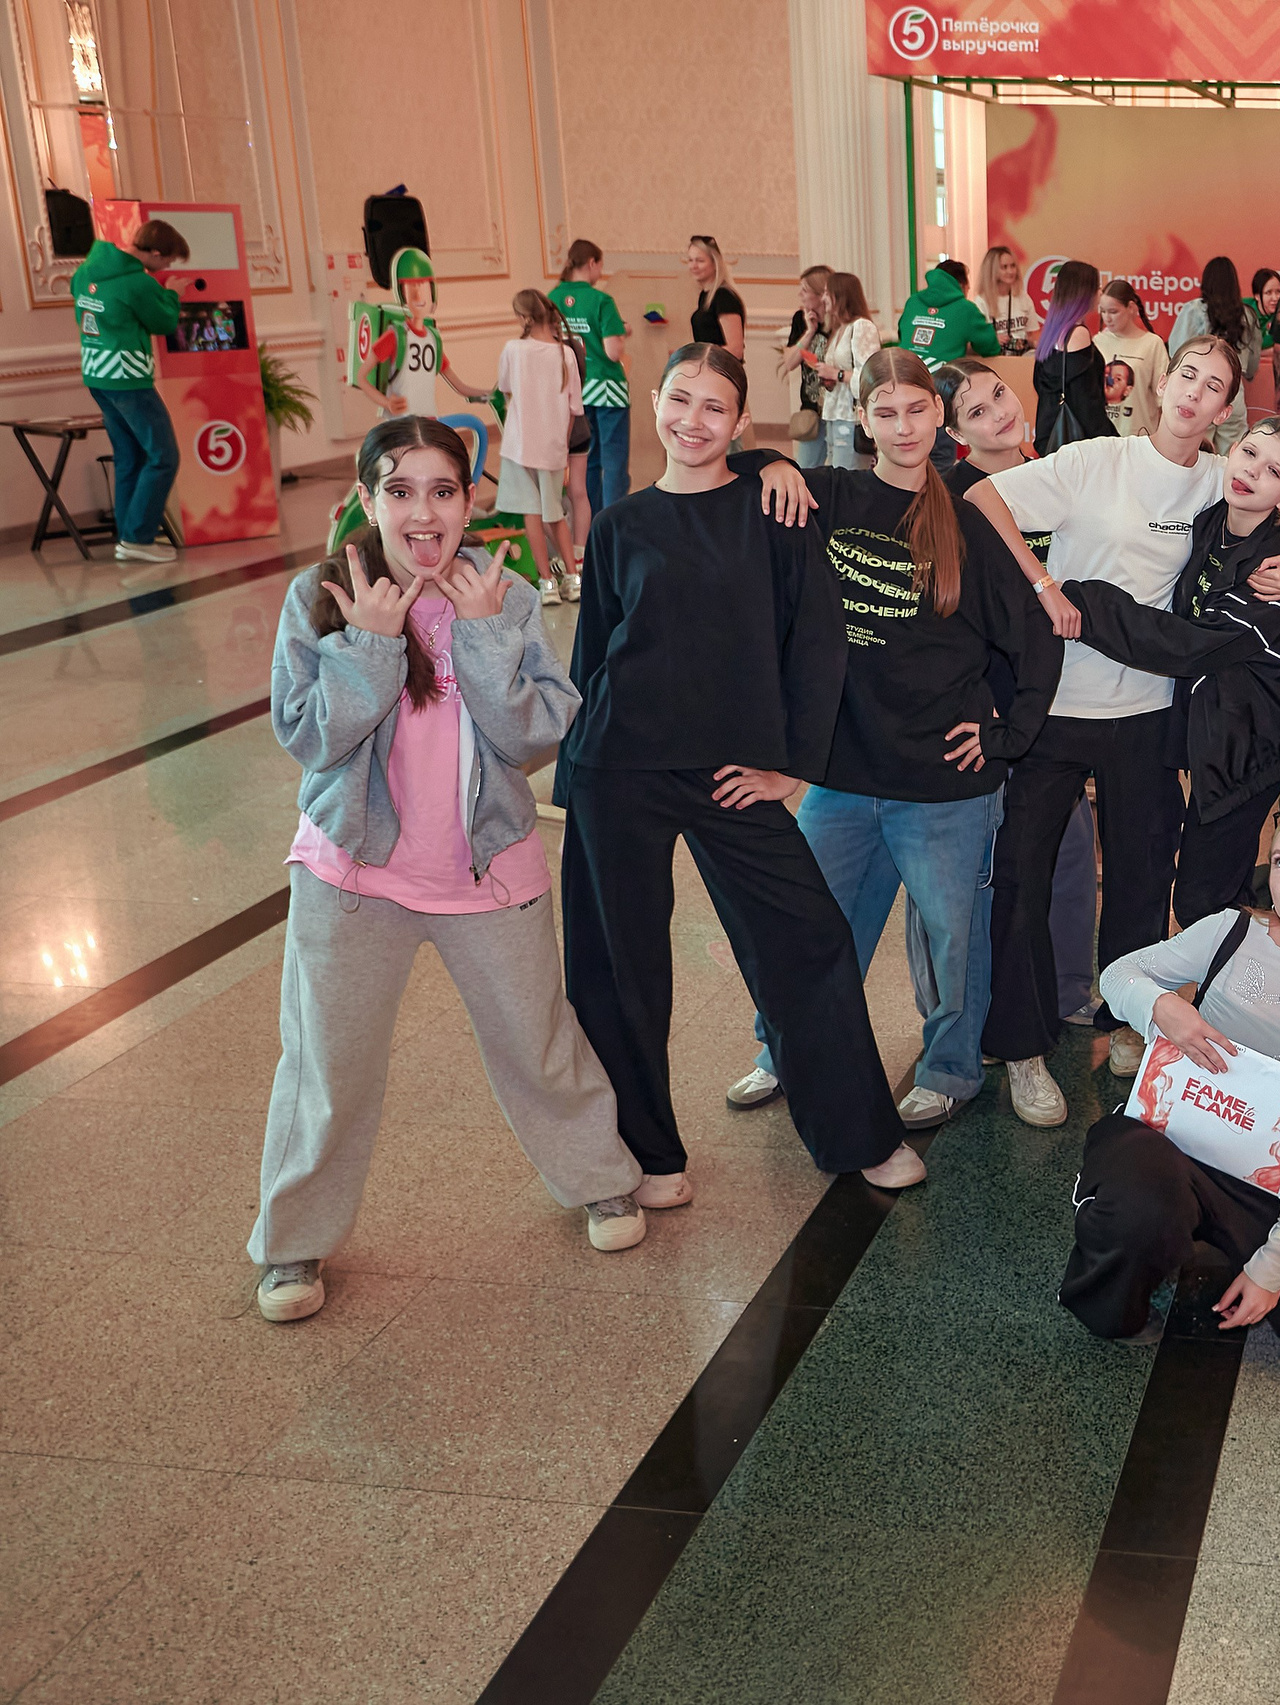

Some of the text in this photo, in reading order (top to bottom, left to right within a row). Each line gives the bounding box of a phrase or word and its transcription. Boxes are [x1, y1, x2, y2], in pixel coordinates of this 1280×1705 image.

[902, 11, 926, 50] 5
[941, 17, 1040, 36] Пятёрочка
[941, 39, 1040, 55] выручает!
[408, 343, 436, 372] 30
[208, 425, 234, 466] 5
[1148, 521, 1191, 533] chaotic
[847, 630, 887, 646] ЕМЕННОГО
[1181, 1088, 1256, 1132] FLAME
[1185, 1077, 1257, 1117] FAME to
